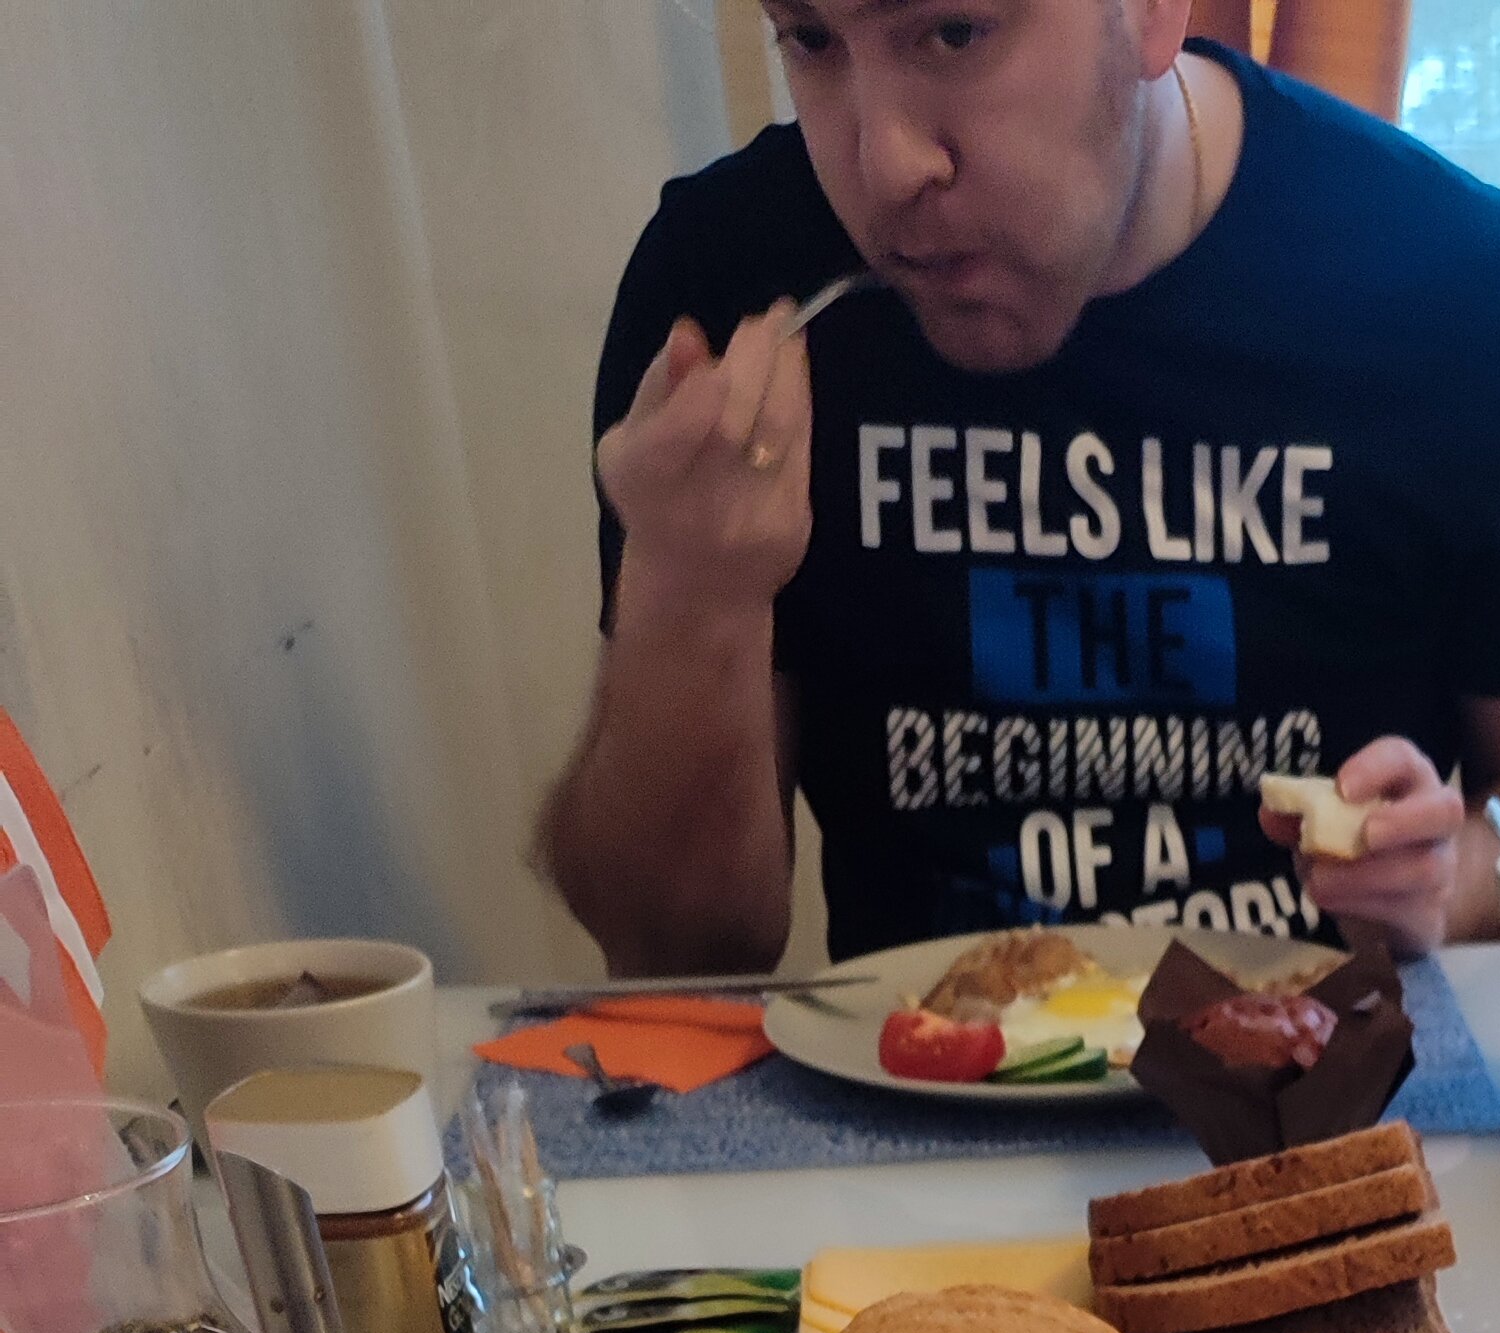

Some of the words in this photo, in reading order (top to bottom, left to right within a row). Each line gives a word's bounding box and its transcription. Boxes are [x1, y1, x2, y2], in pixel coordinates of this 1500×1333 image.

[858, 424, 1122, 559] FEELS
[1142, 437, 1332, 564] LIKE
[1014, 580, 1192, 691] THE
[1019, 808, 1113, 910] OF
[1143, 804, 1190, 894] A
